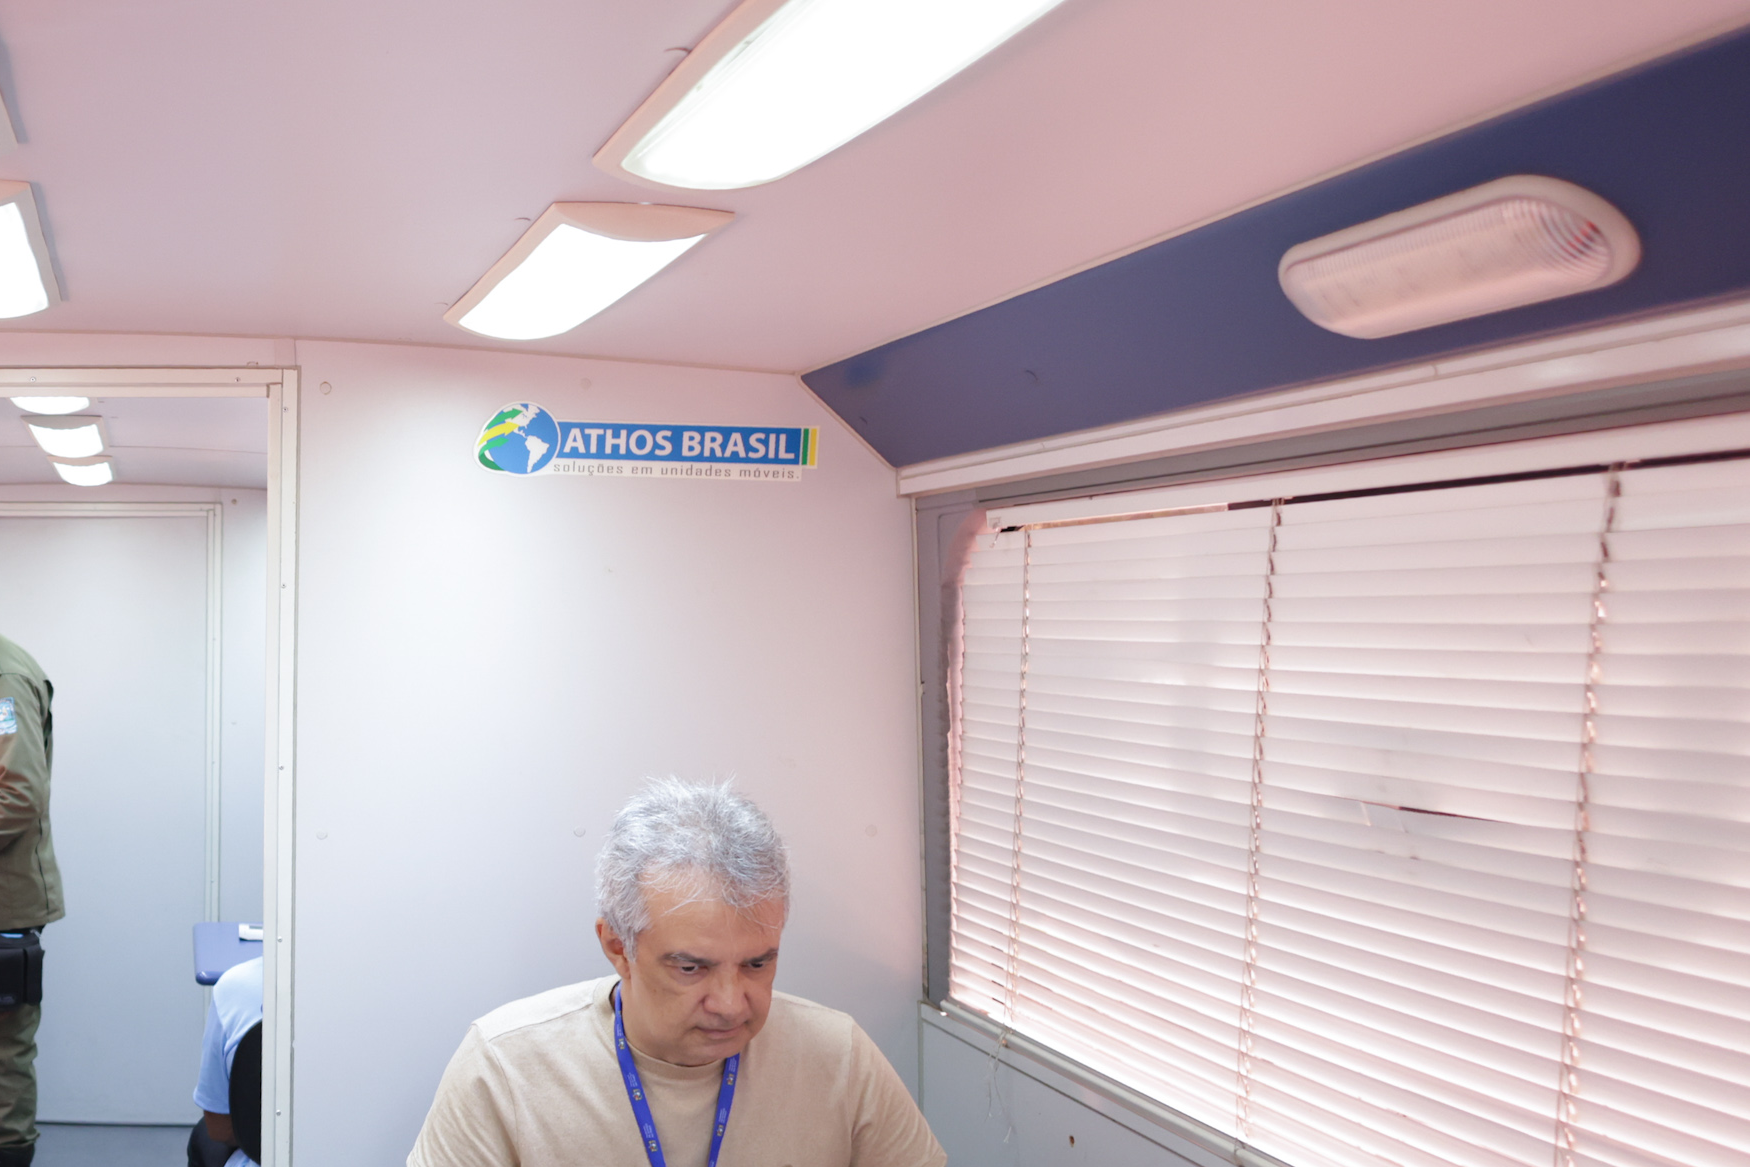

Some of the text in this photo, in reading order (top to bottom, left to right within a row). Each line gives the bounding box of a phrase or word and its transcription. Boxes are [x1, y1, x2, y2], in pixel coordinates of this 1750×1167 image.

[563, 428, 795, 460] ATHOS BRASIL
[553, 462, 624, 476] soluções
[631, 465, 654, 476] em
[660, 464, 732, 477] unidades
